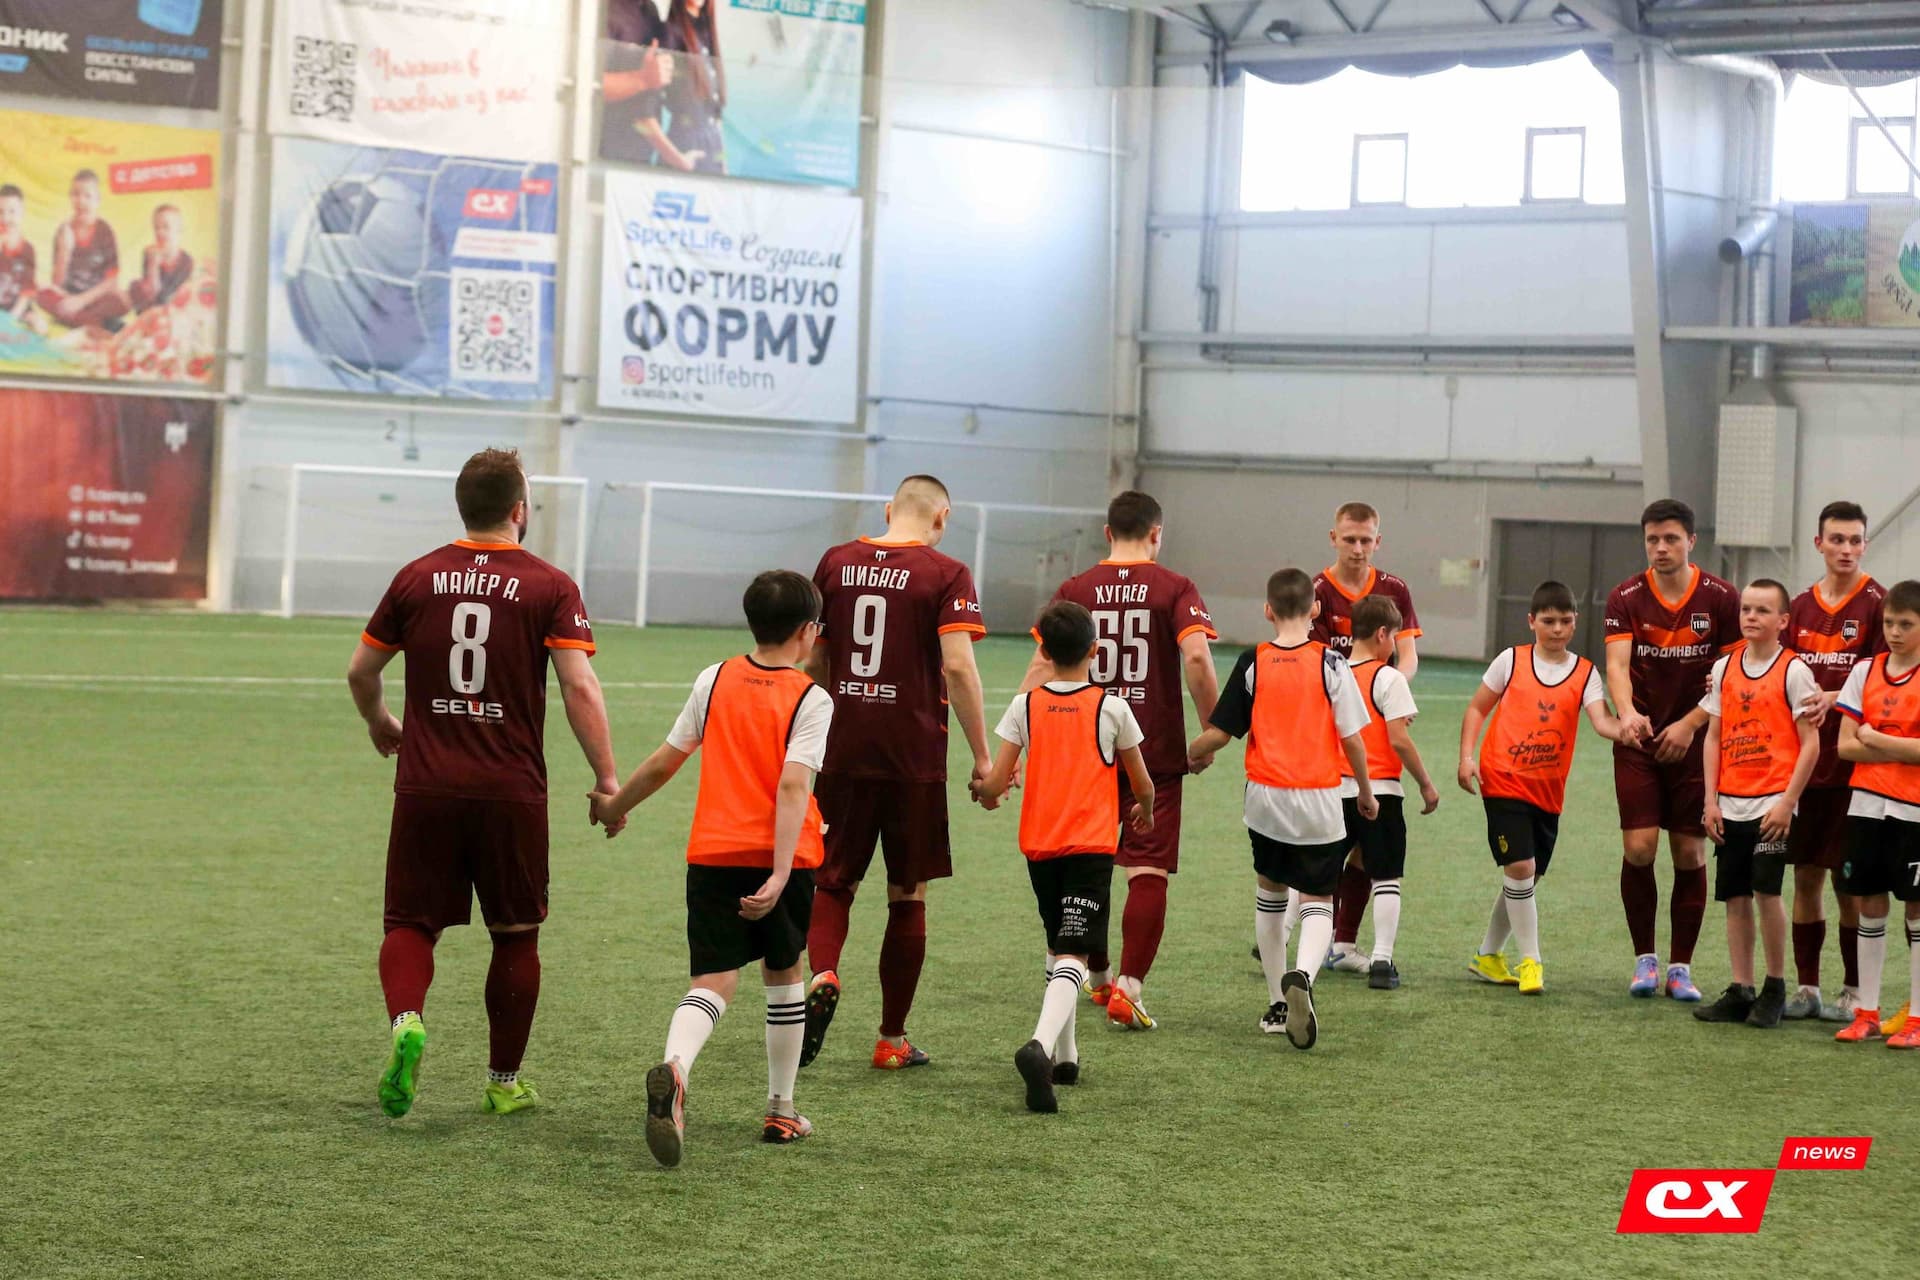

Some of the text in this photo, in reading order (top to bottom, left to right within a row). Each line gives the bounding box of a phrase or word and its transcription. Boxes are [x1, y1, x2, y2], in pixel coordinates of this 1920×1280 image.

[625, 262, 838, 308] СПОРТИВНУЮ
[624, 299, 836, 365] ФОРМУ
[433, 568, 520, 602] МАЙЕР А.
[841, 565, 910, 591] ШИБАЕВ
[1095, 584, 1148, 604] ХУГАЕВ
[450, 602, 491, 694] 8
[850, 594, 887, 677] 9
[1637, 644, 1711, 658] ПРОДИНВЕСТ
[839, 681, 897, 698] SEUS
[432, 699, 503, 718] SEUS
